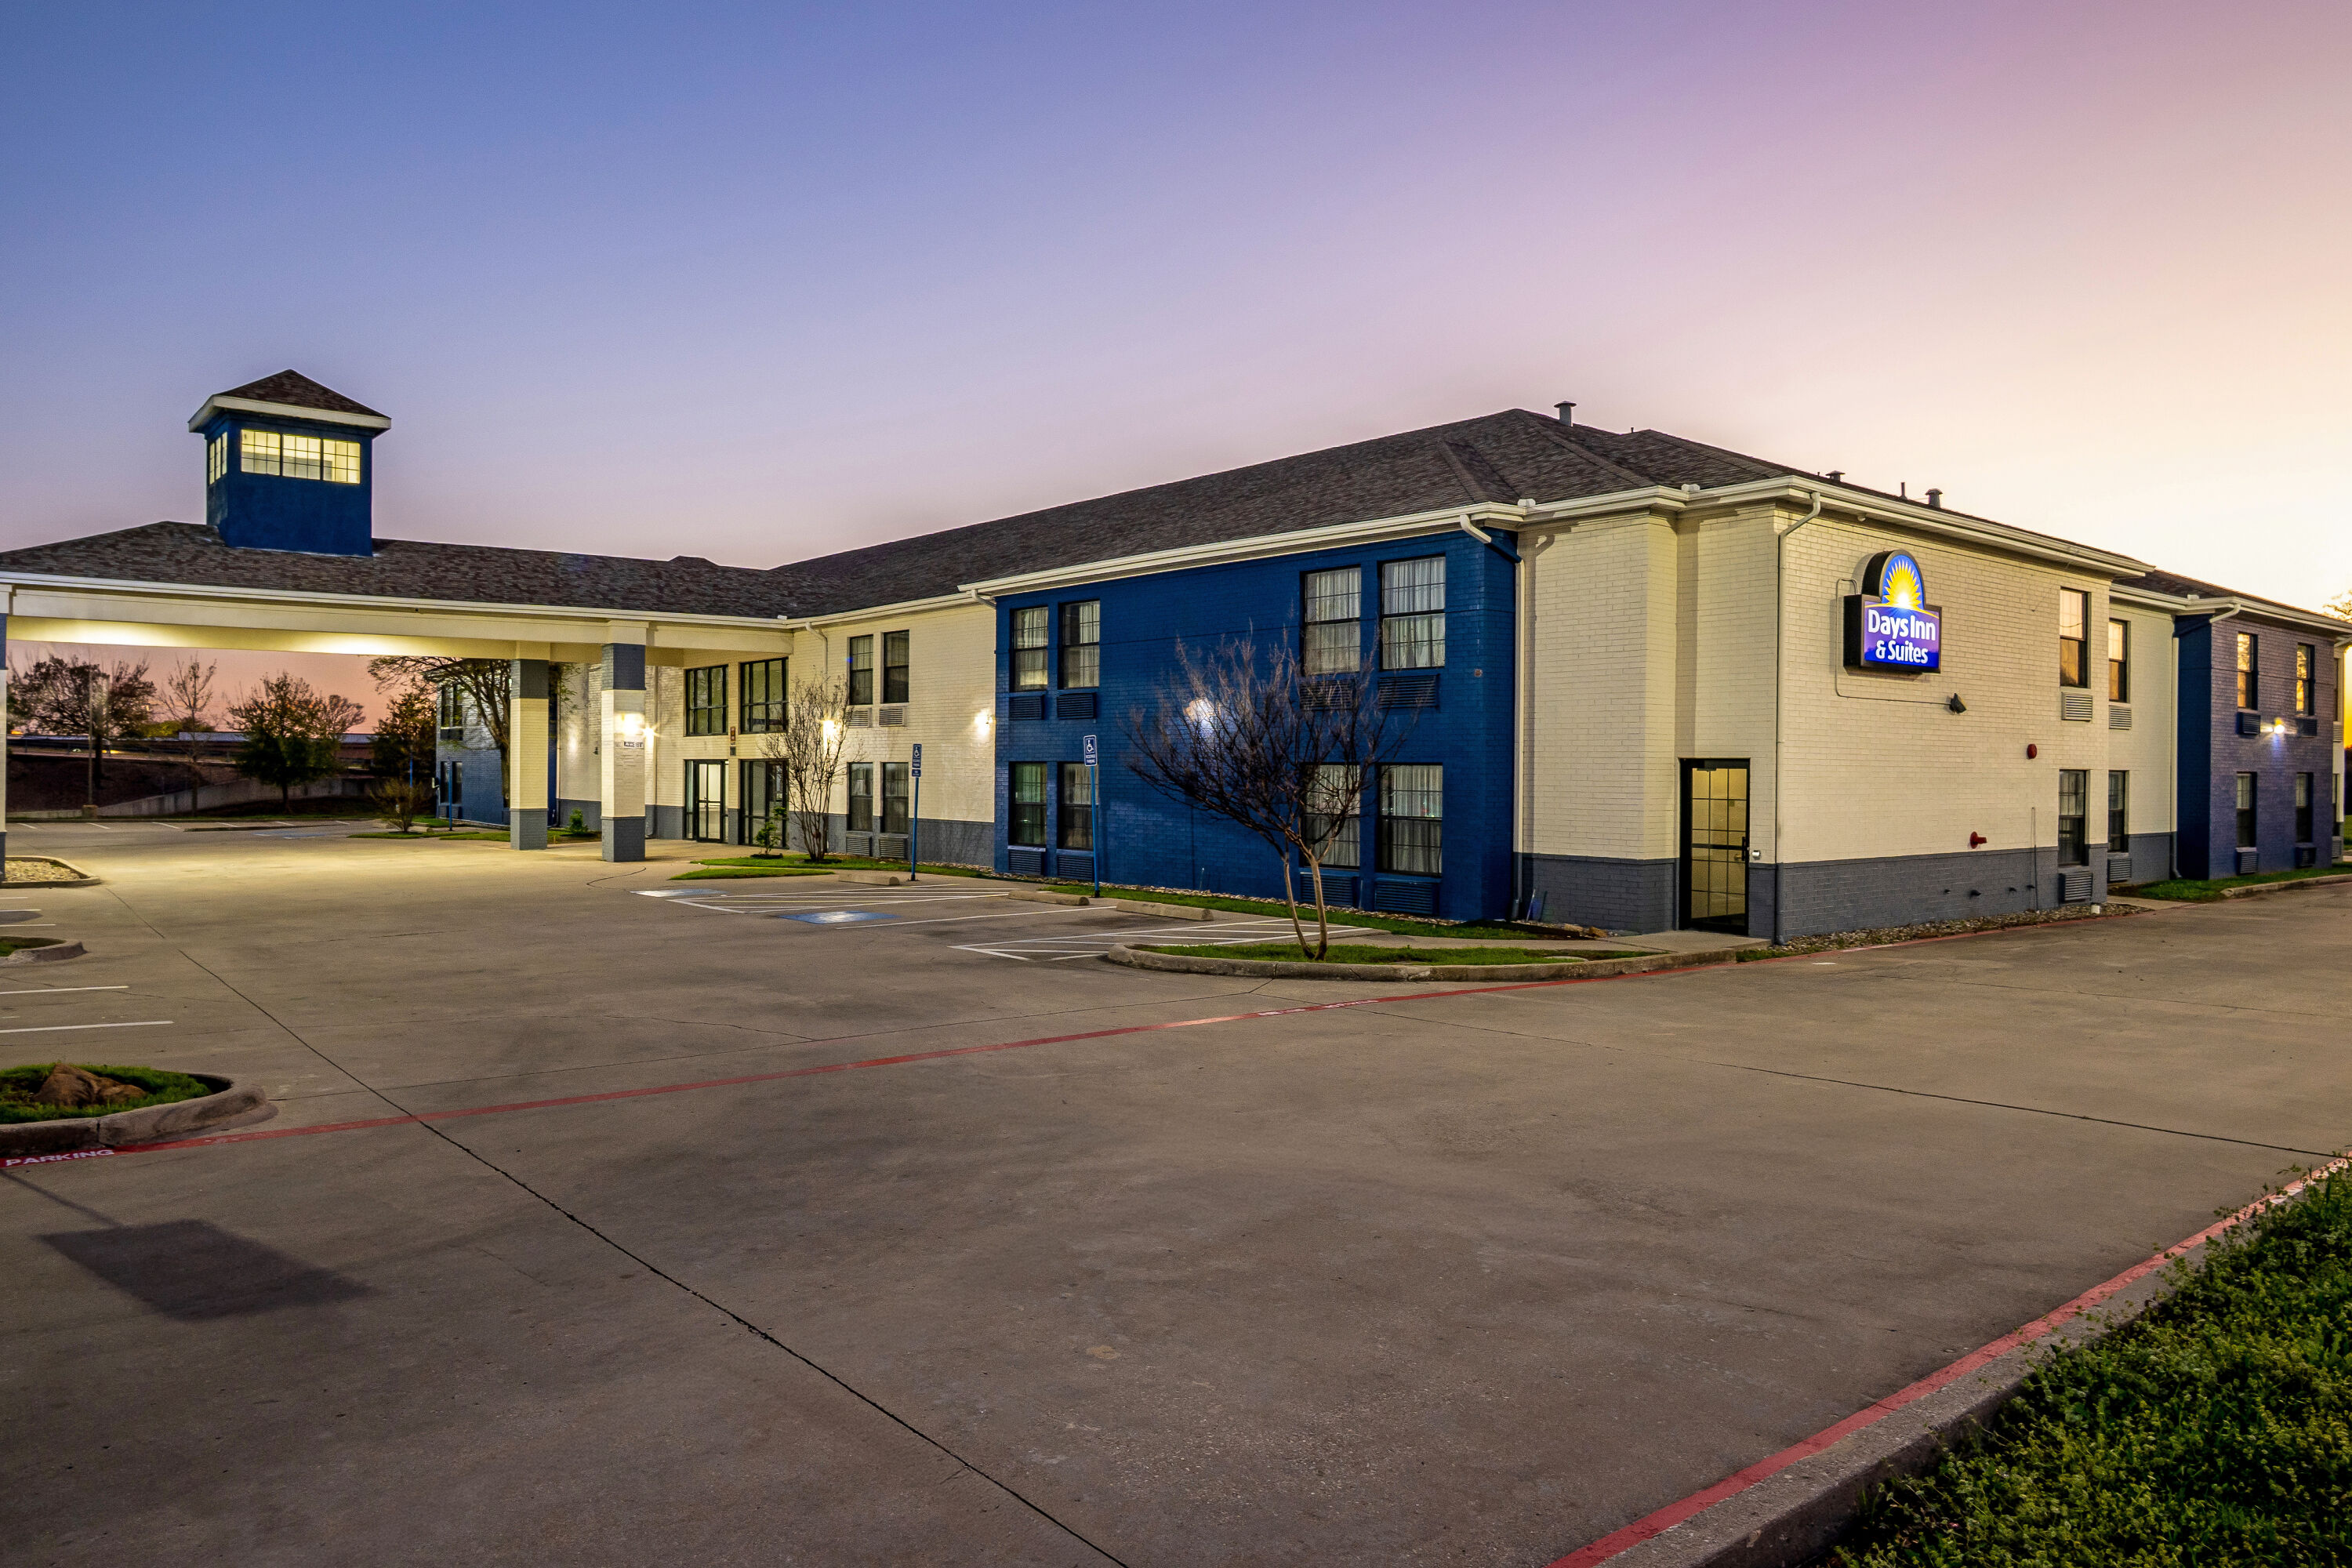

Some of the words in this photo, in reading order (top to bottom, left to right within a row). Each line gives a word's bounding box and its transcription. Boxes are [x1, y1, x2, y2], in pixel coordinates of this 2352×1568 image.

[1868, 609, 1909, 639] Days
[1910, 615, 1936, 641] Inn
[1875, 640, 1886, 659] &
[1887, 640, 1929, 663] Suites
[5, 1149, 114, 1167] PARKING
